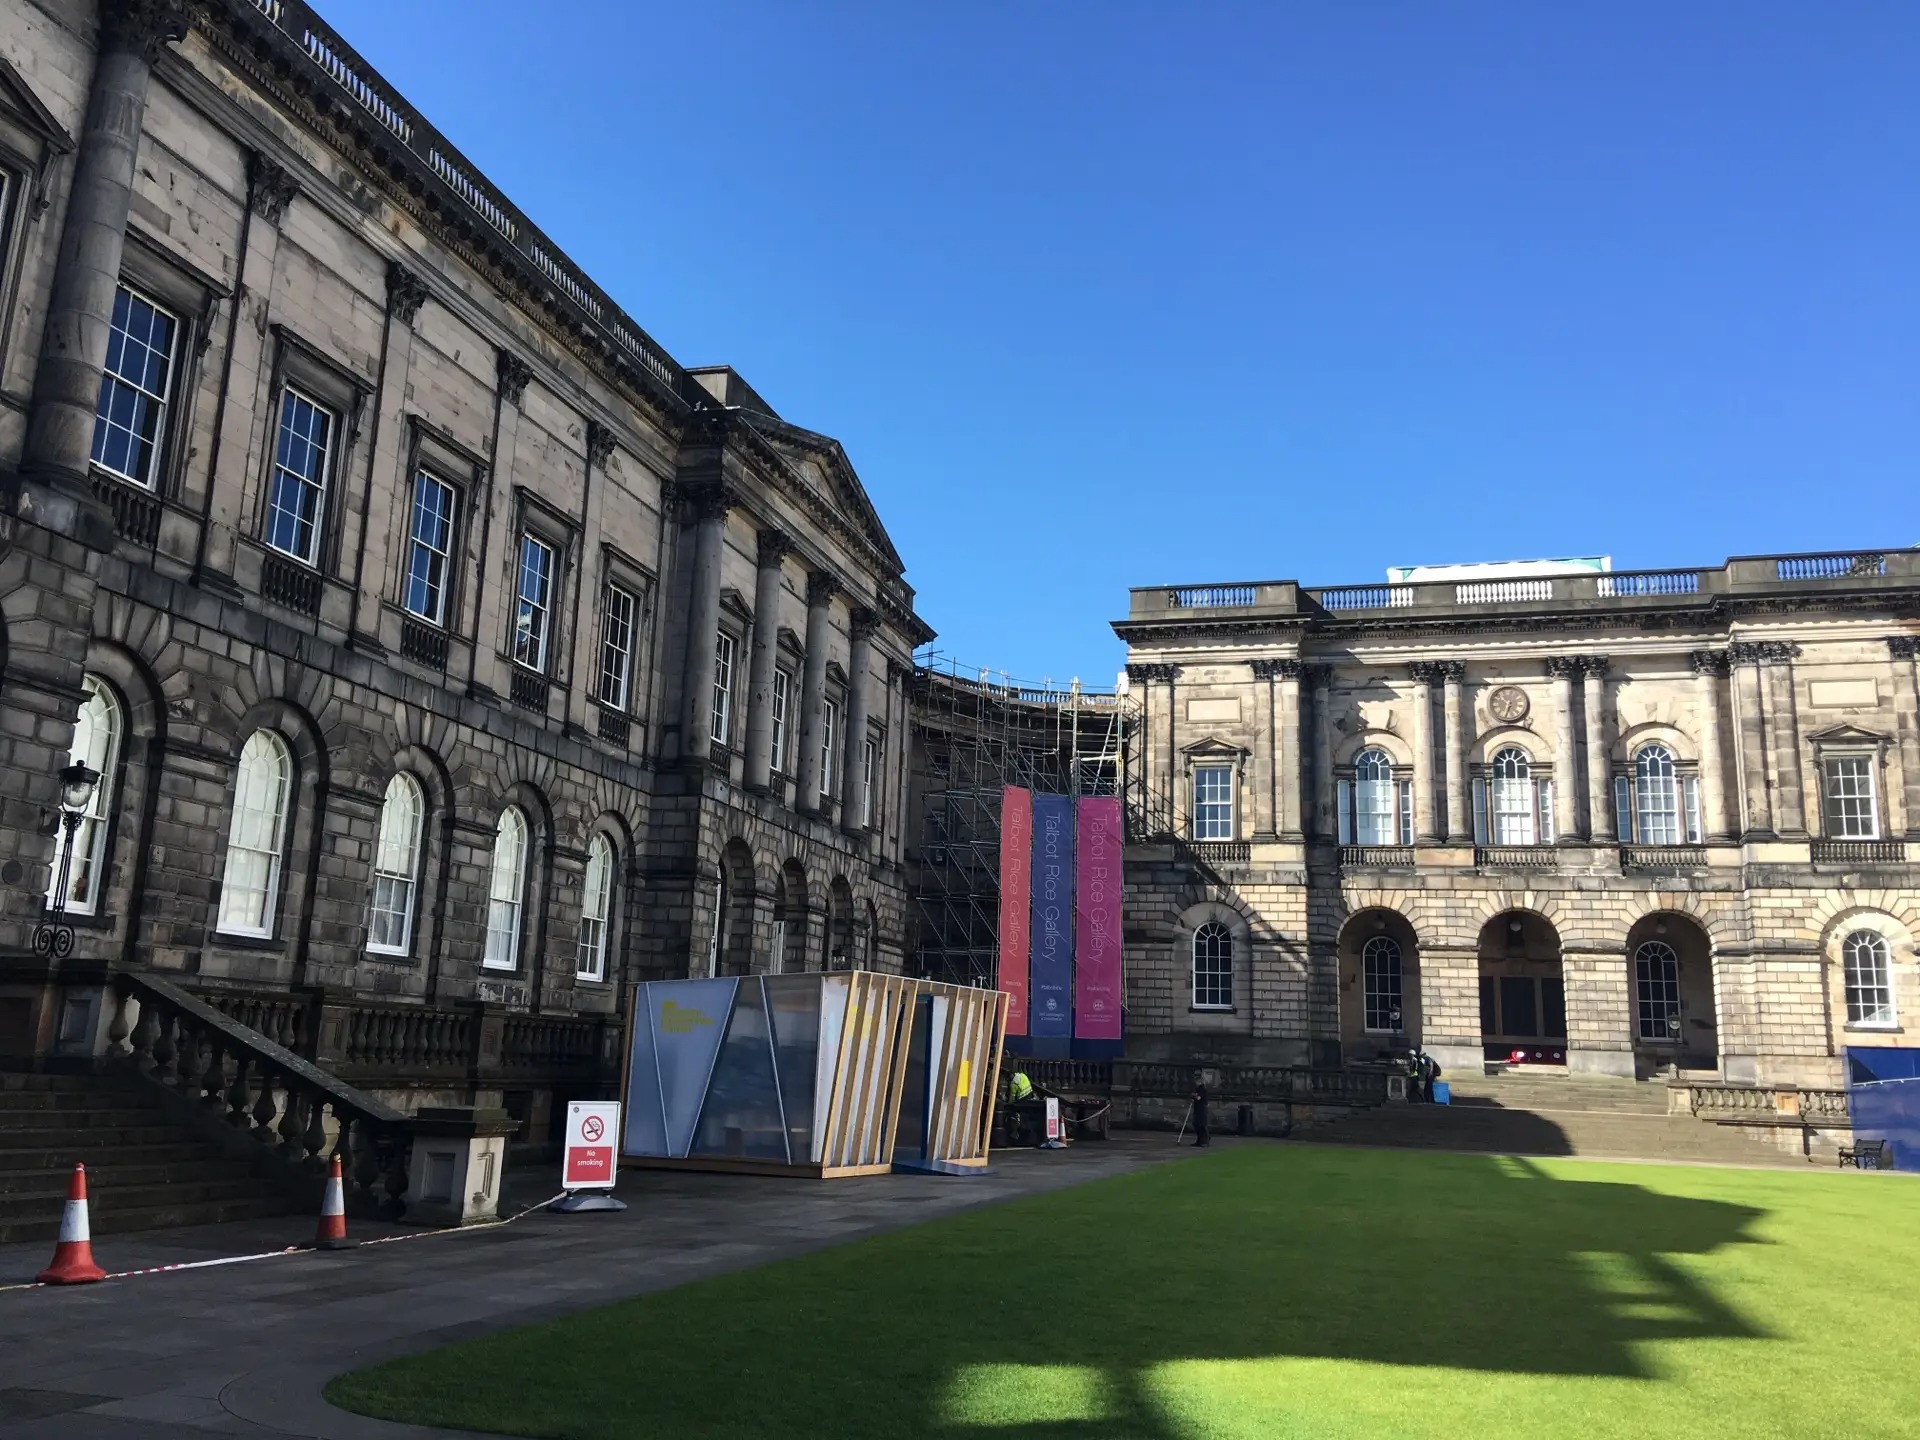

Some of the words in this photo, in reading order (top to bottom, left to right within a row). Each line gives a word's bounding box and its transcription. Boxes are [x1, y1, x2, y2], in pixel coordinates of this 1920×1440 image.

[1010, 806, 1023, 852] Talbot
[1045, 812, 1060, 859] Talbot
[1091, 814, 1107, 861] Talbot
[1009, 858, 1021, 895] Rice
[1045, 864, 1060, 900] Rice
[1091, 867, 1107, 903] Rice
[1008, 900, 1021, 957] Gallery
[1042, 906, 1060, 962] Gallery
[1088, 908, 1107, 963] Gallery
[577, 1159, 604, 1167] smoking
